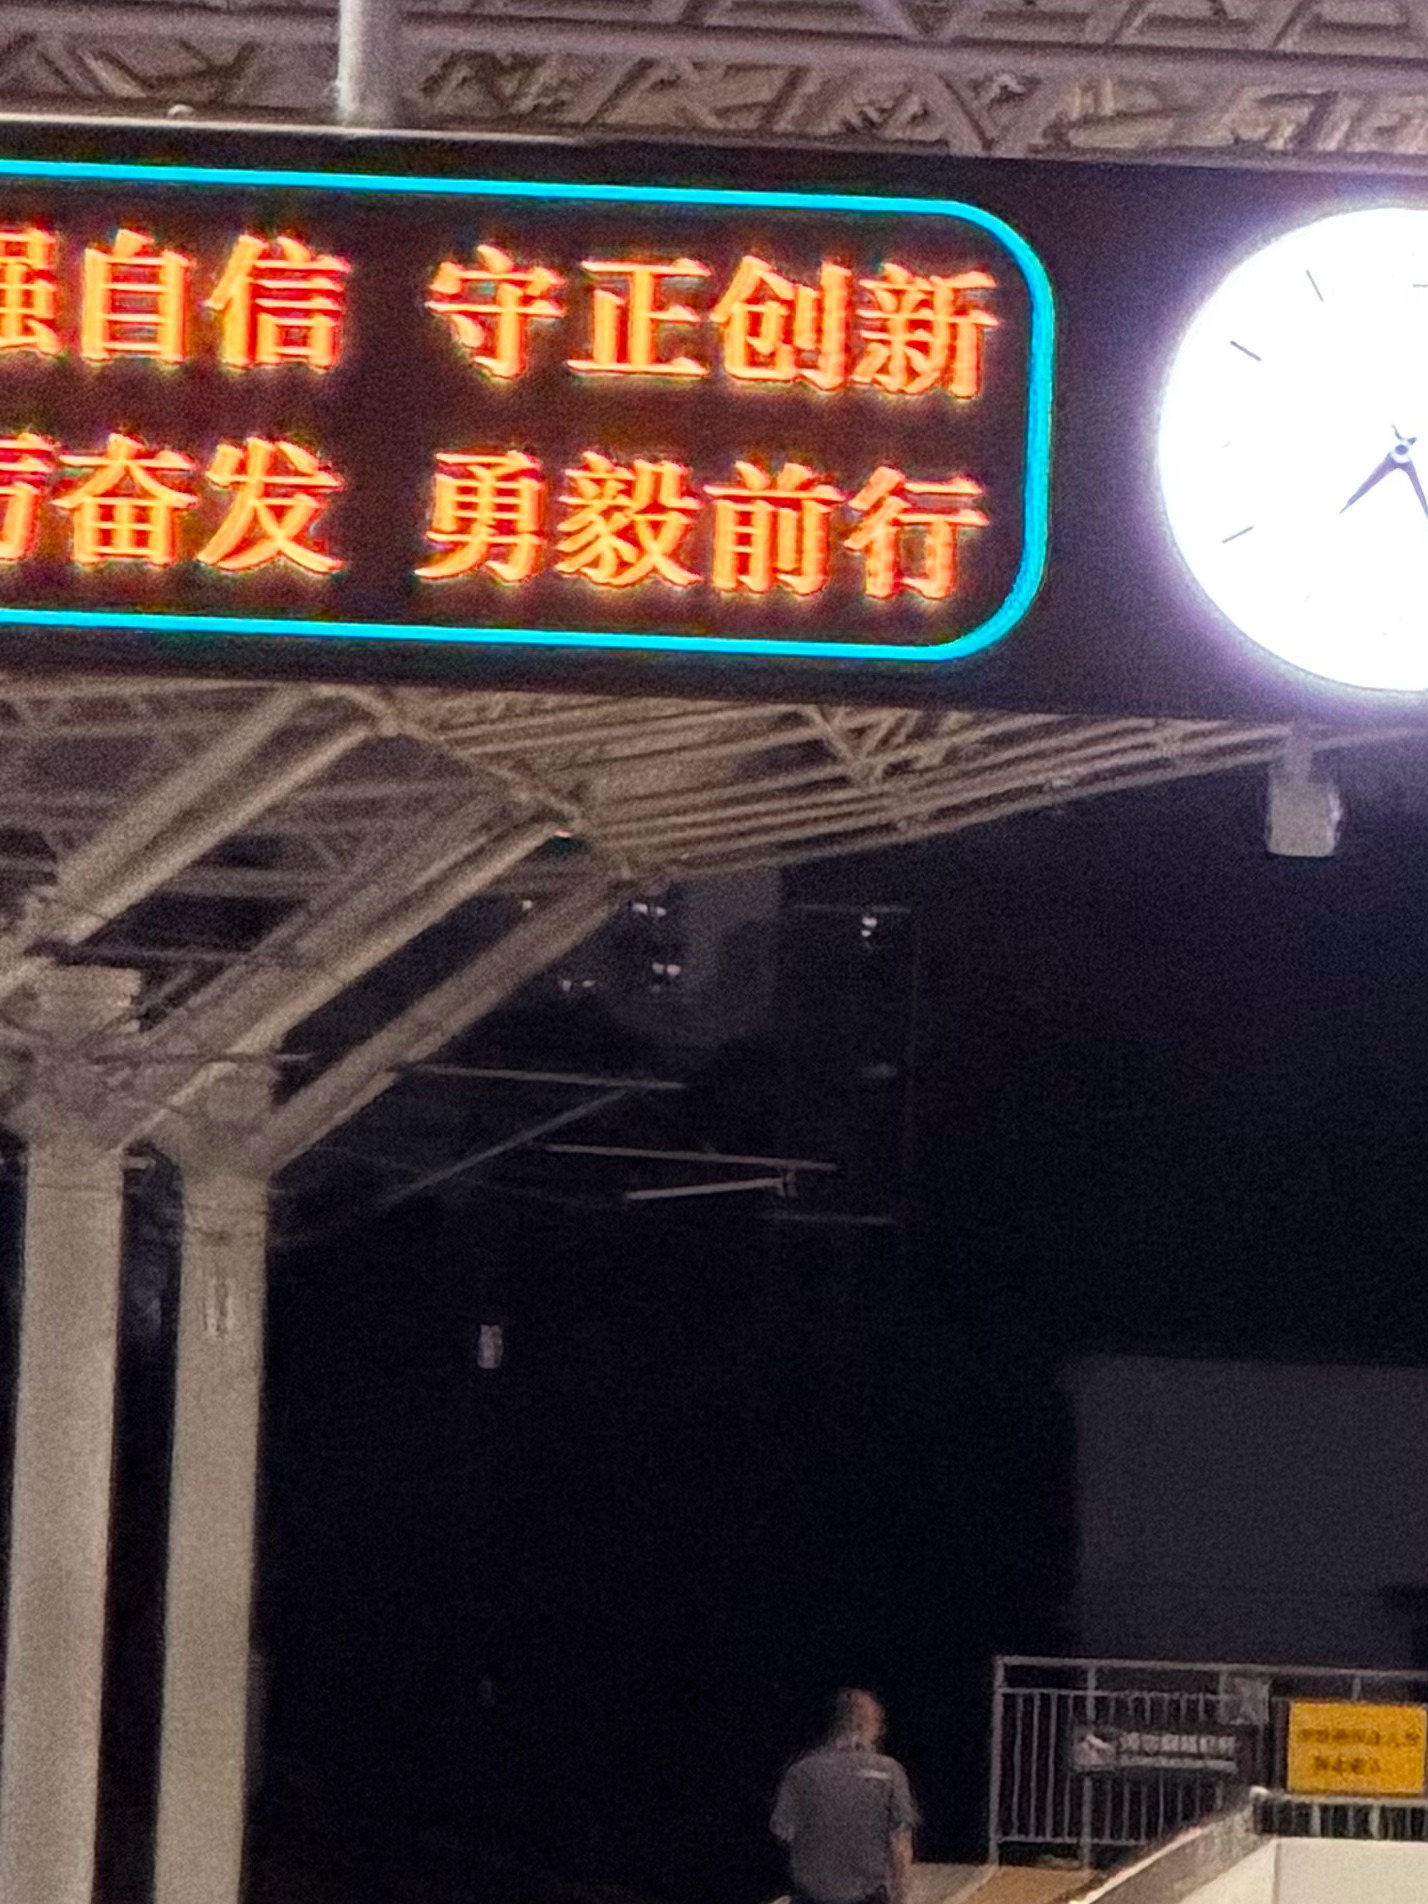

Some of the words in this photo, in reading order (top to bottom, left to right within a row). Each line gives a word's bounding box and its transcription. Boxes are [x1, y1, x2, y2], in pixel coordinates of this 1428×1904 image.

[426, 244, 1000, 400] 守正创新
[414, 450, 991, 601] 勇毅前行
